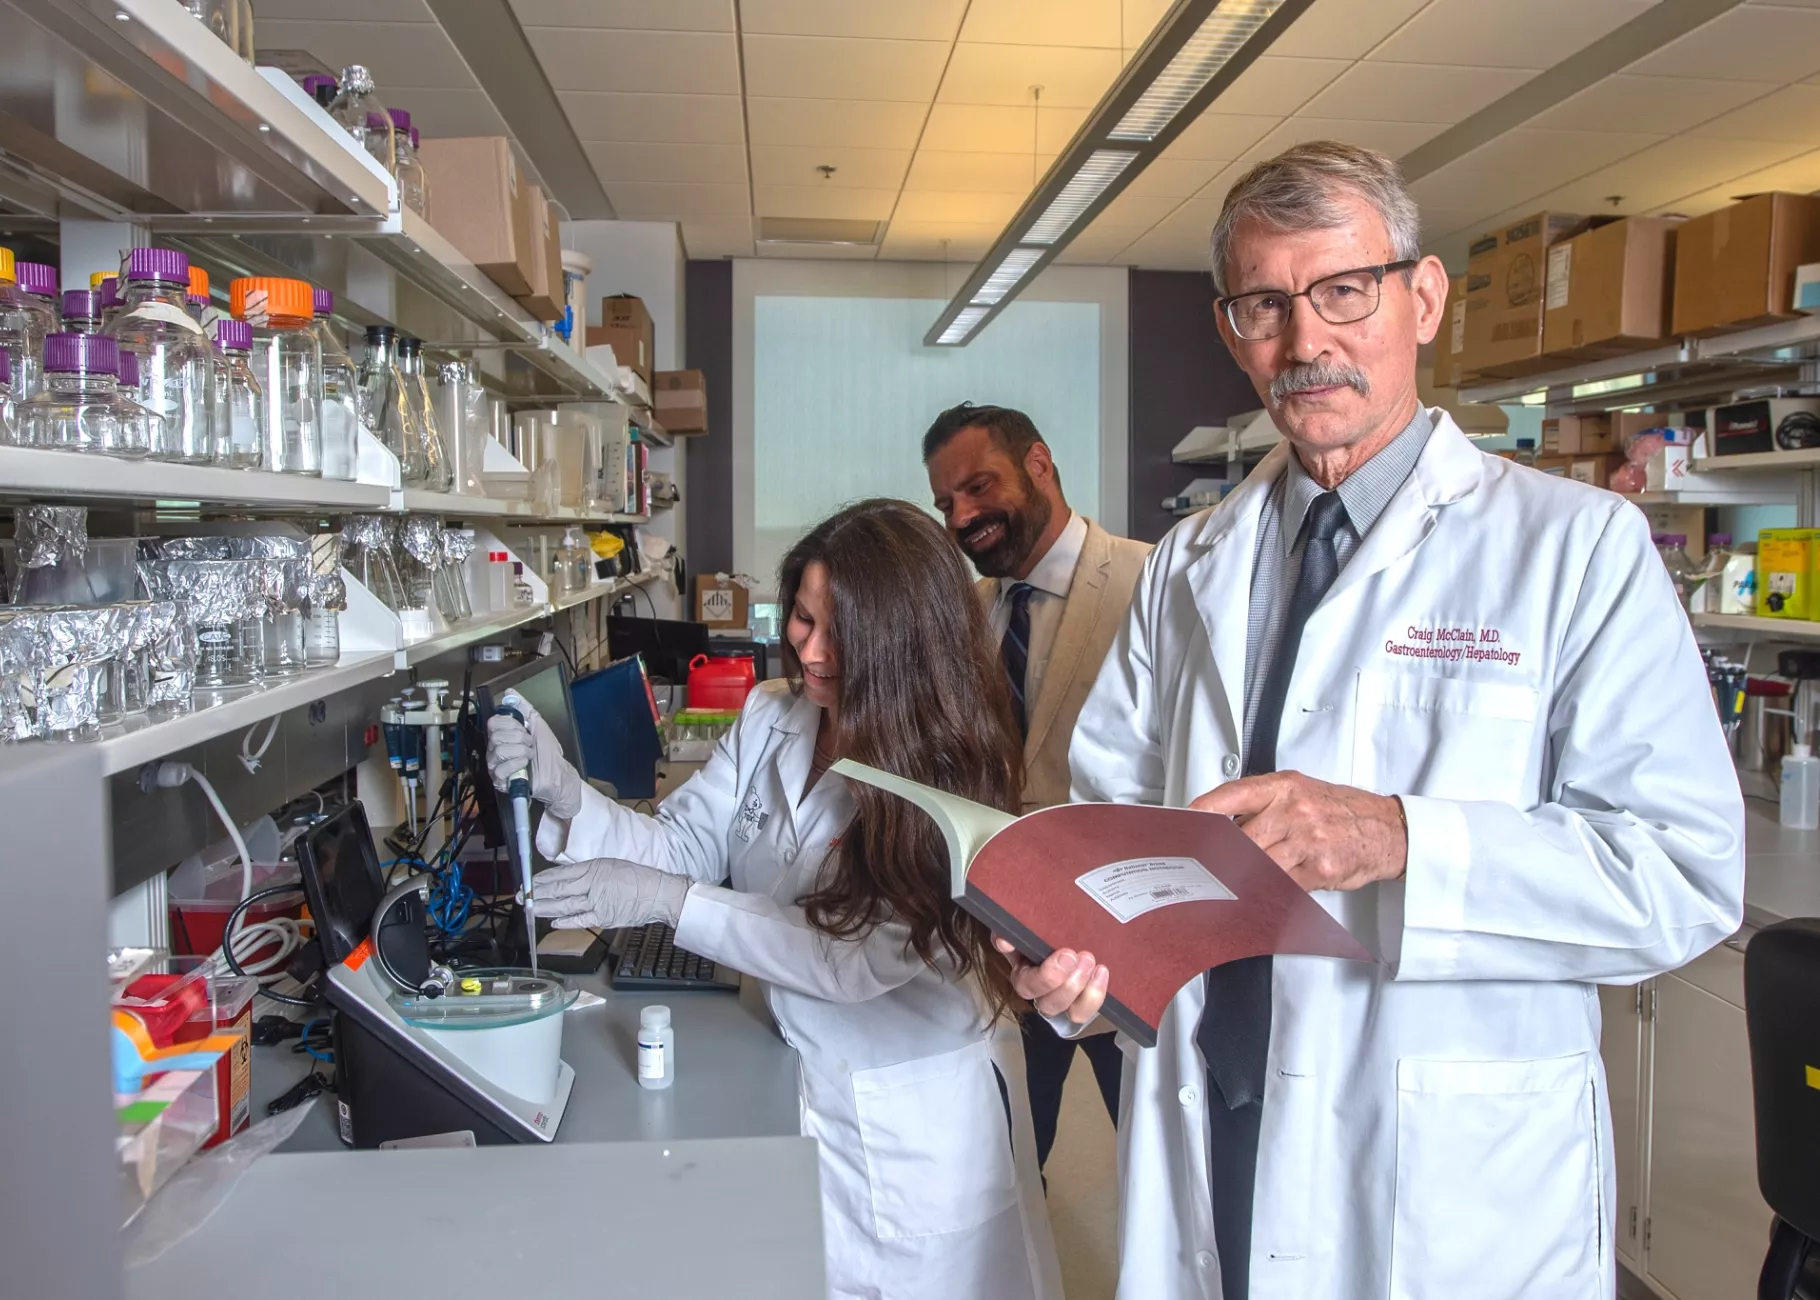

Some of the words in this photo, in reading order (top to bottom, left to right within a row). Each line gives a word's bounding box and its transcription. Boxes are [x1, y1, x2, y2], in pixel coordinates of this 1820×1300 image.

[1407, 626, 1433, 643] Craig
[1436, 628, 1476, 643] McClain,
[1479, 629, 1501, 643] M.D.
[1385, 640, 1521, 666] Gastroenterology/Hepatology
